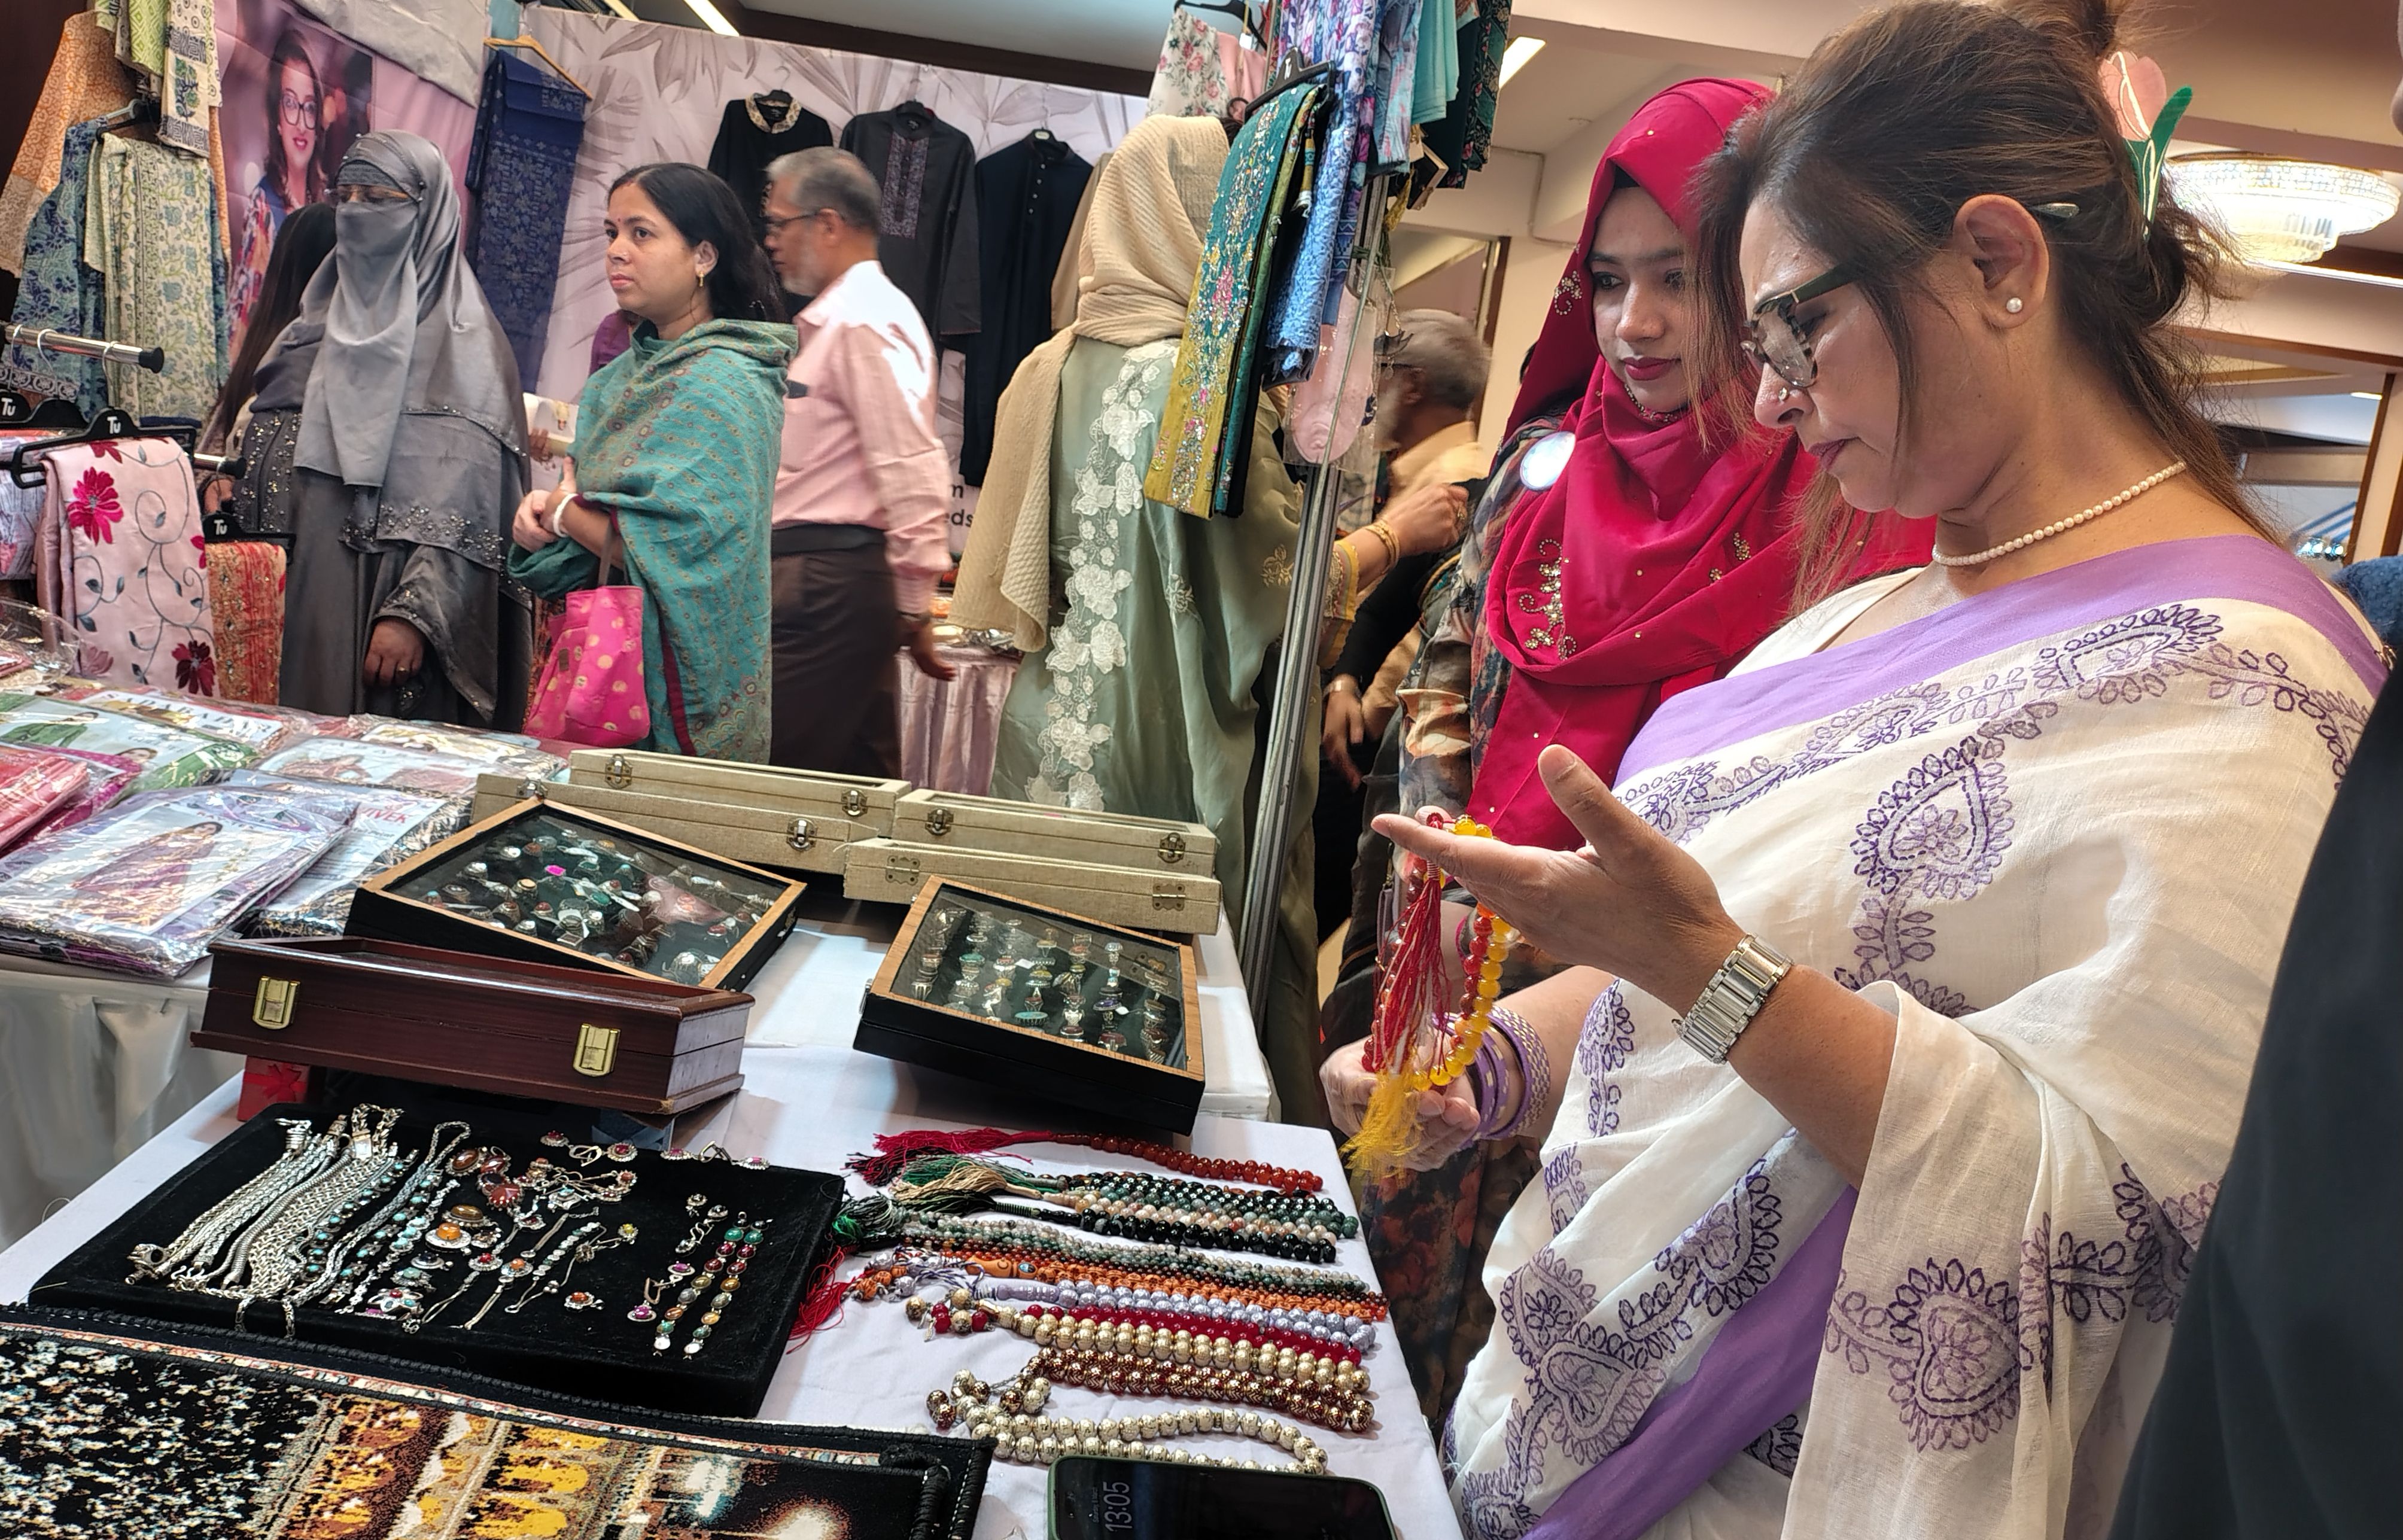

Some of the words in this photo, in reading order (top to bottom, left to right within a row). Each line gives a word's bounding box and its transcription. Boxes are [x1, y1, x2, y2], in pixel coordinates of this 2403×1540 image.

[1, 397, 16, 416] Tu
[107, 416, 121, 434] Tu
[214, 519, 227, 535] Tu
[1103, 1481, 1133, 1532] 13:05
